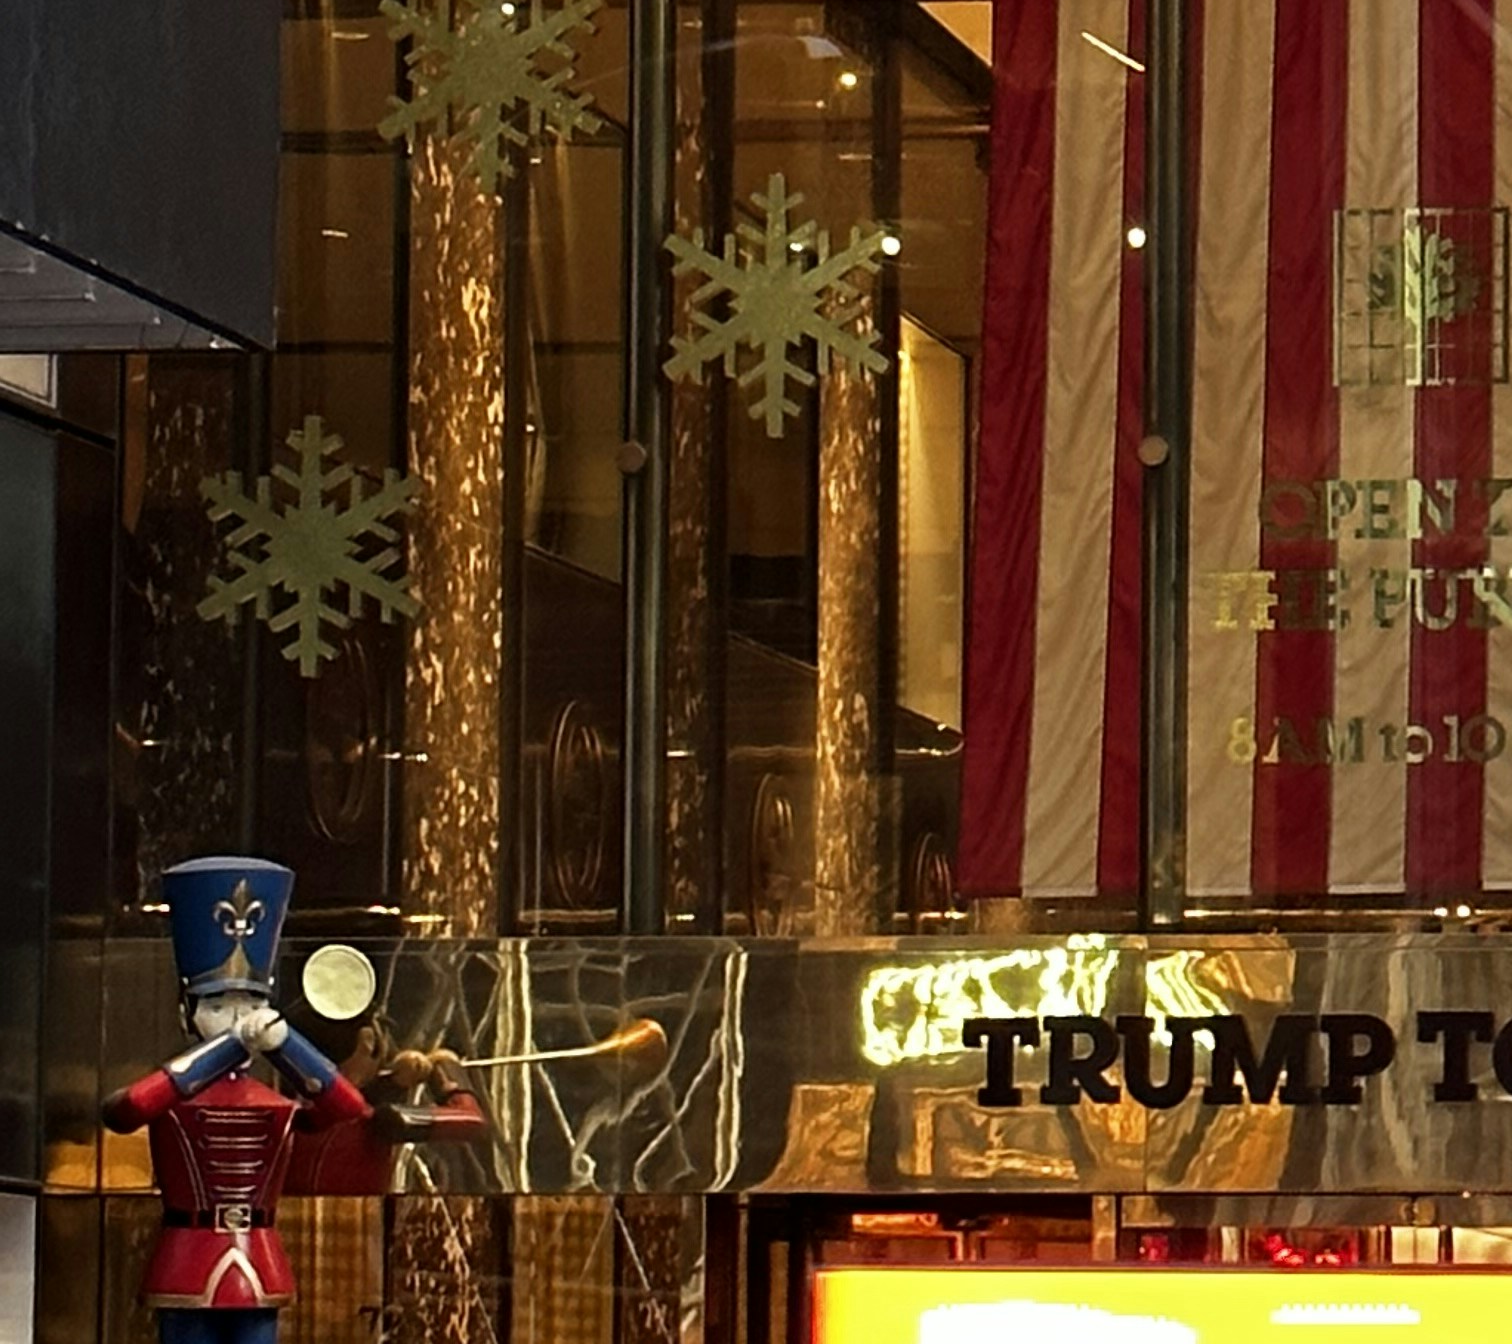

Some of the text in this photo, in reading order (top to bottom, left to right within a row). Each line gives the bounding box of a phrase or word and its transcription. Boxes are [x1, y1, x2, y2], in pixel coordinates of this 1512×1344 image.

[1258, 478, 1458, 540] OPEN
[1205, 570, 1350, 631] THE
[962, 1012, 1396, 1109] TRUMP
